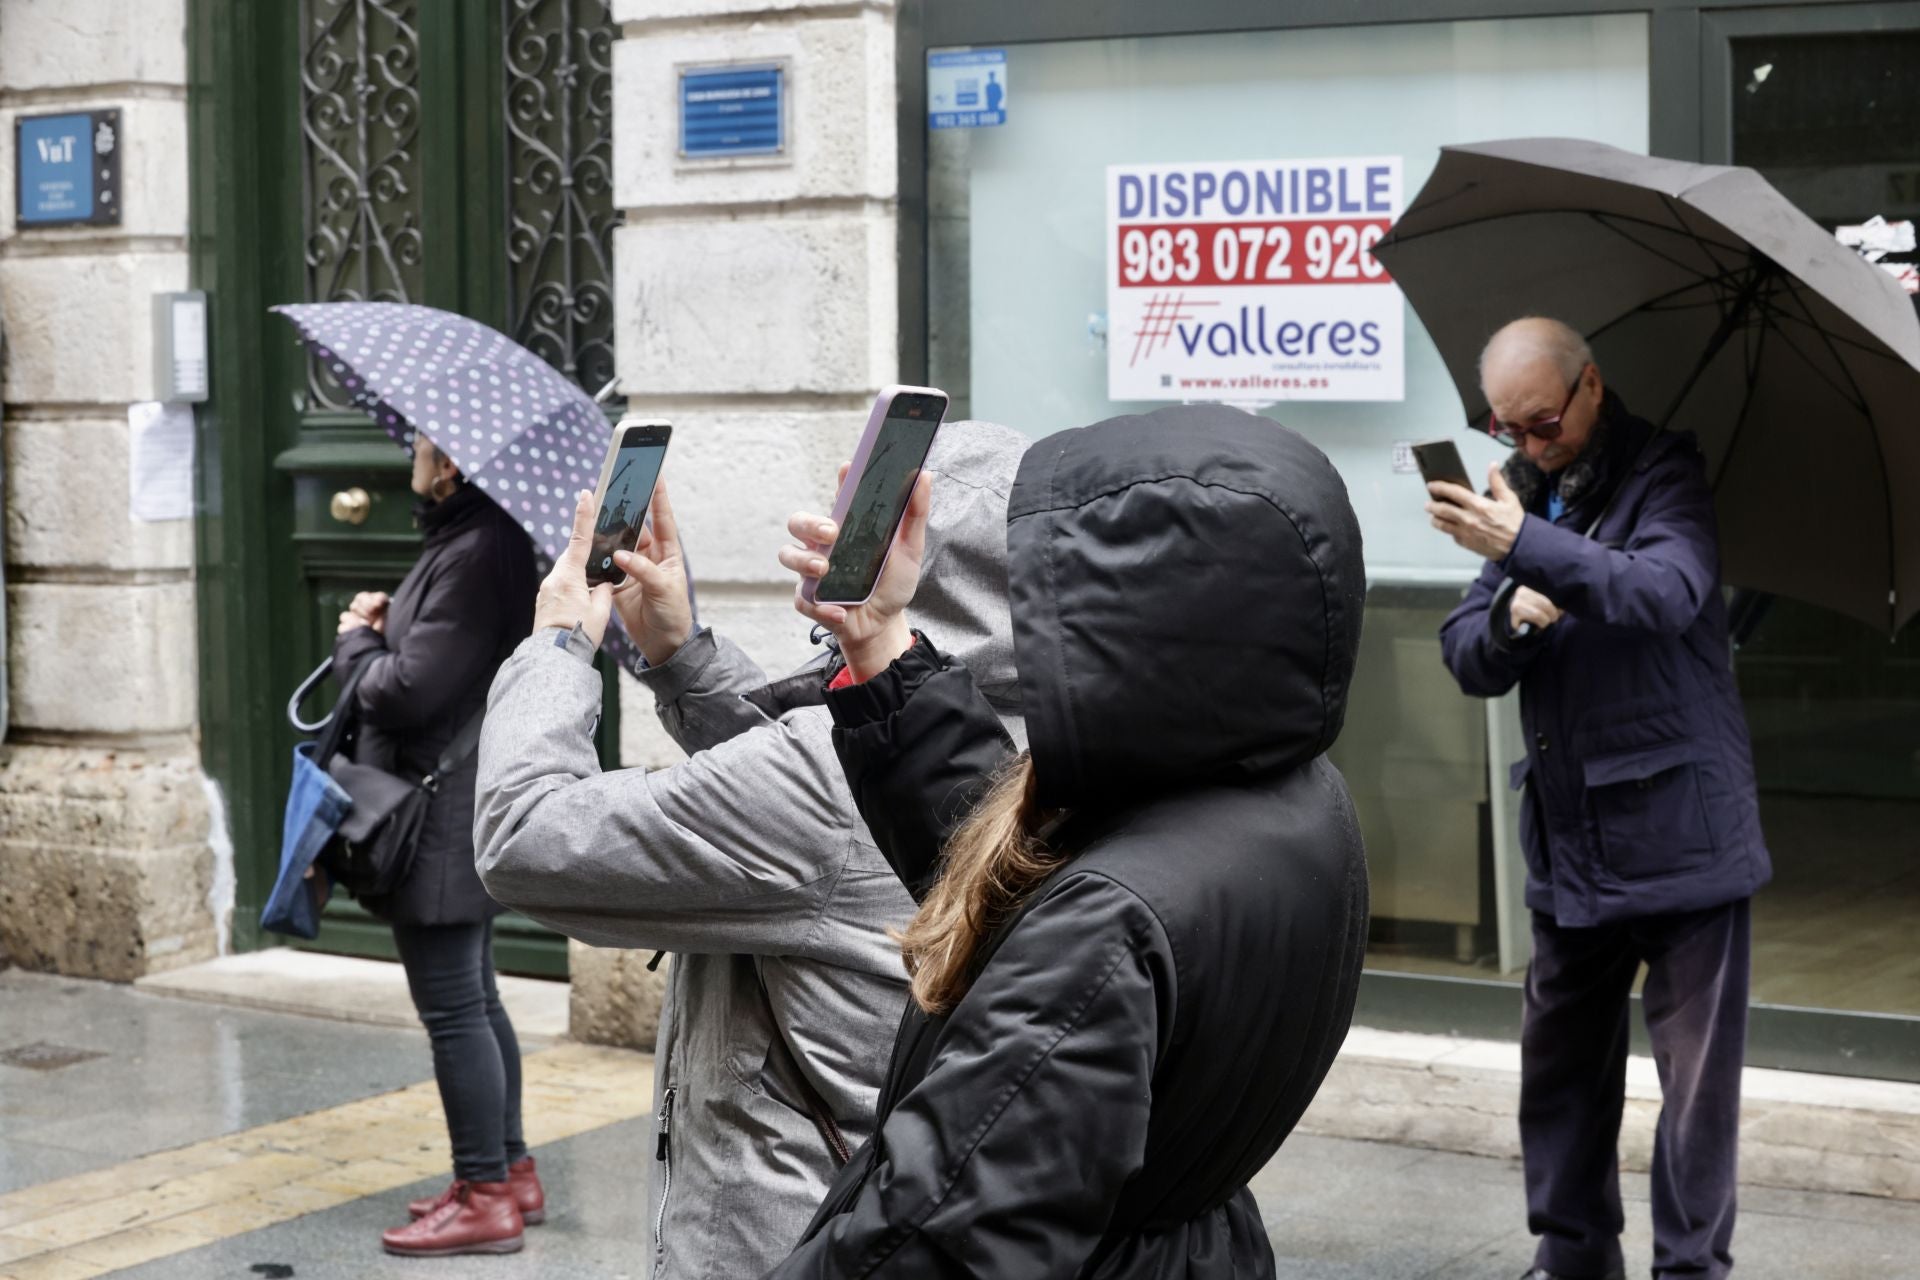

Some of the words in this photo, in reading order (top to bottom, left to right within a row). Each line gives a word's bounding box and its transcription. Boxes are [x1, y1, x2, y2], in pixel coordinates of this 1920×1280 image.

[1119, 166, 1391, 218] DISPONIBLE
[1123, 229, 1200, 282] 983
[1213, 226, 1292, 281] 072
[1180, 375, 1329, 388] www.valleres.es
